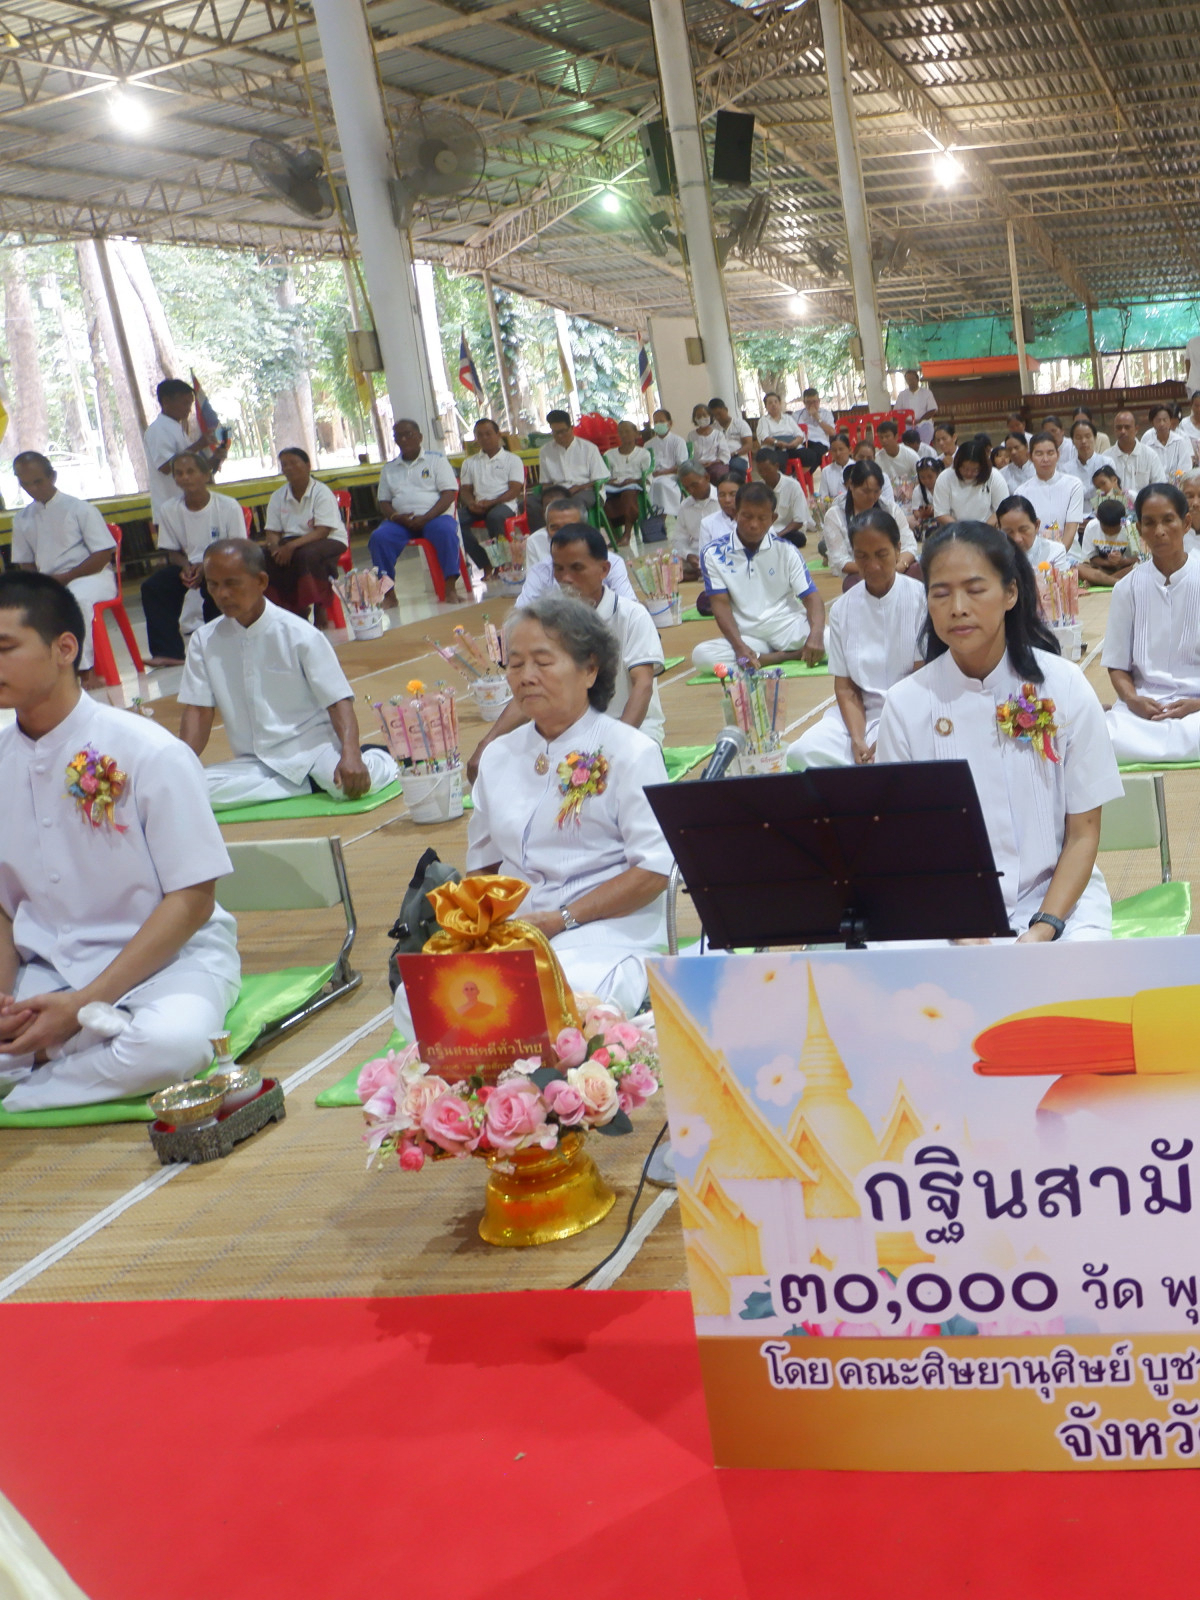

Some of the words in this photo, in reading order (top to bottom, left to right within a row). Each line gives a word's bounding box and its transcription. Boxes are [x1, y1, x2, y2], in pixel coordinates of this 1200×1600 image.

[780, 1271, 1059, 1325] ๓๐,๐๐๐
[1081, 1262, 1145, 1310] วัด
[765, 1344, 829, 1385] โดย
[839, 1344, 1132, 1399] คณะศิษยานุศิษย์
